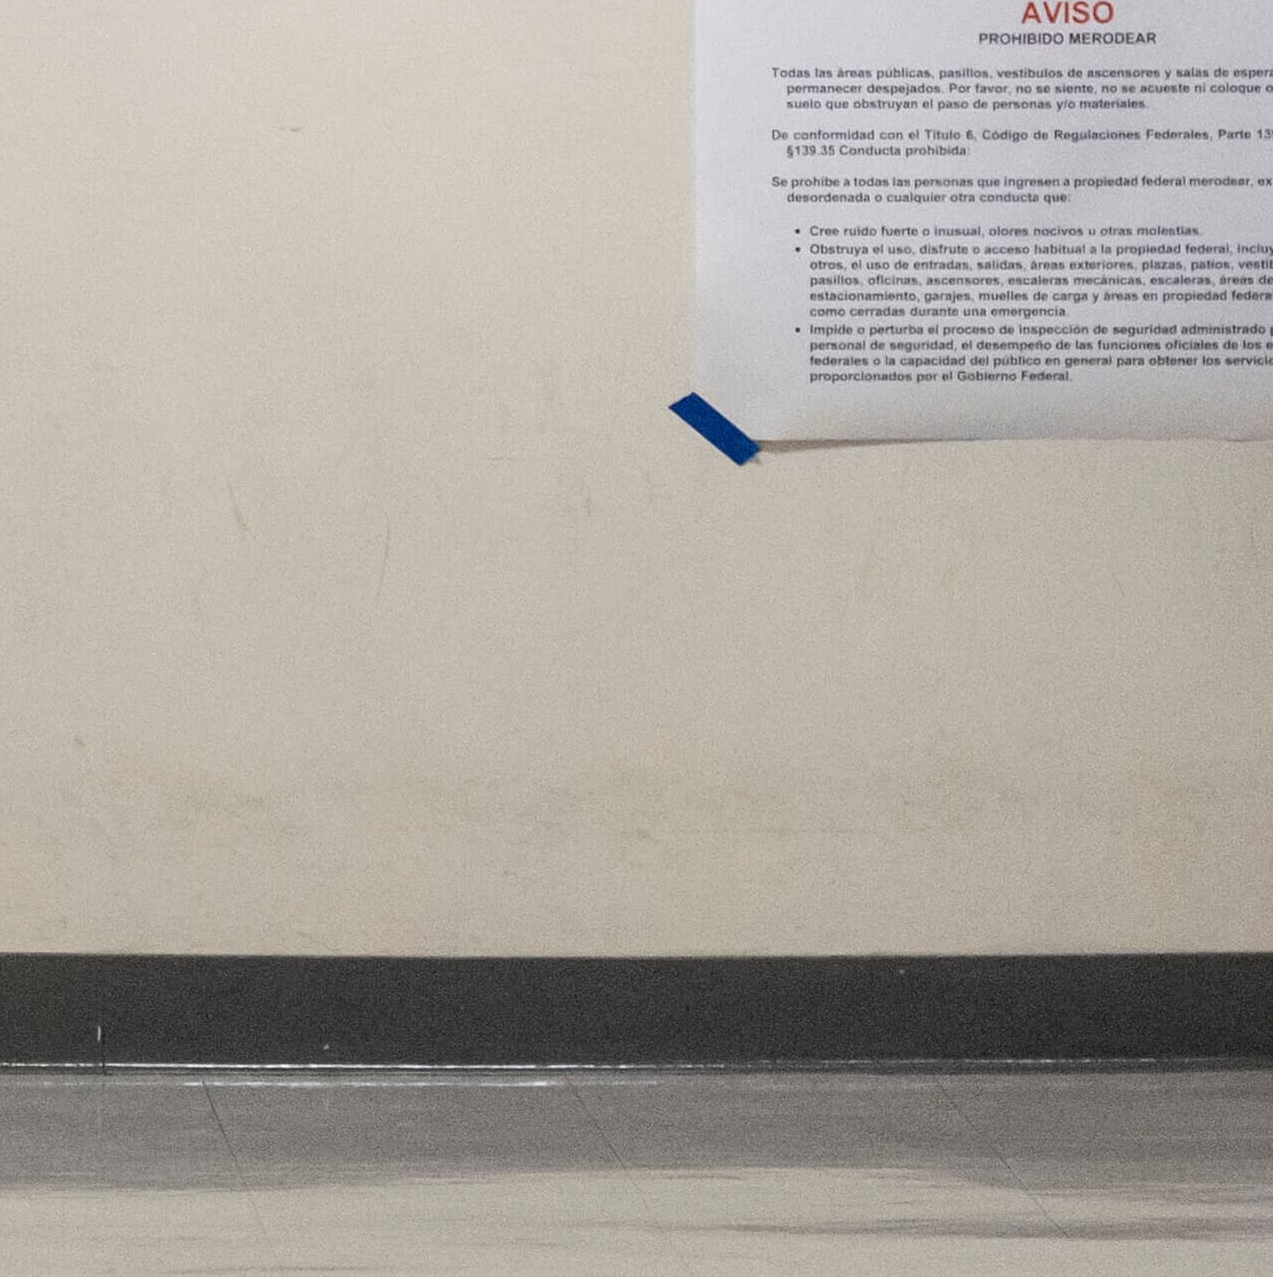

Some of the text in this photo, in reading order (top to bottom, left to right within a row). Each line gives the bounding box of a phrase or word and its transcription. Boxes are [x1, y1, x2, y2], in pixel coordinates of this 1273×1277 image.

[1021, 0, 1114, 24] AVISO
[978, 32, 1157, 45] PROHIBIDO MERODEAR
